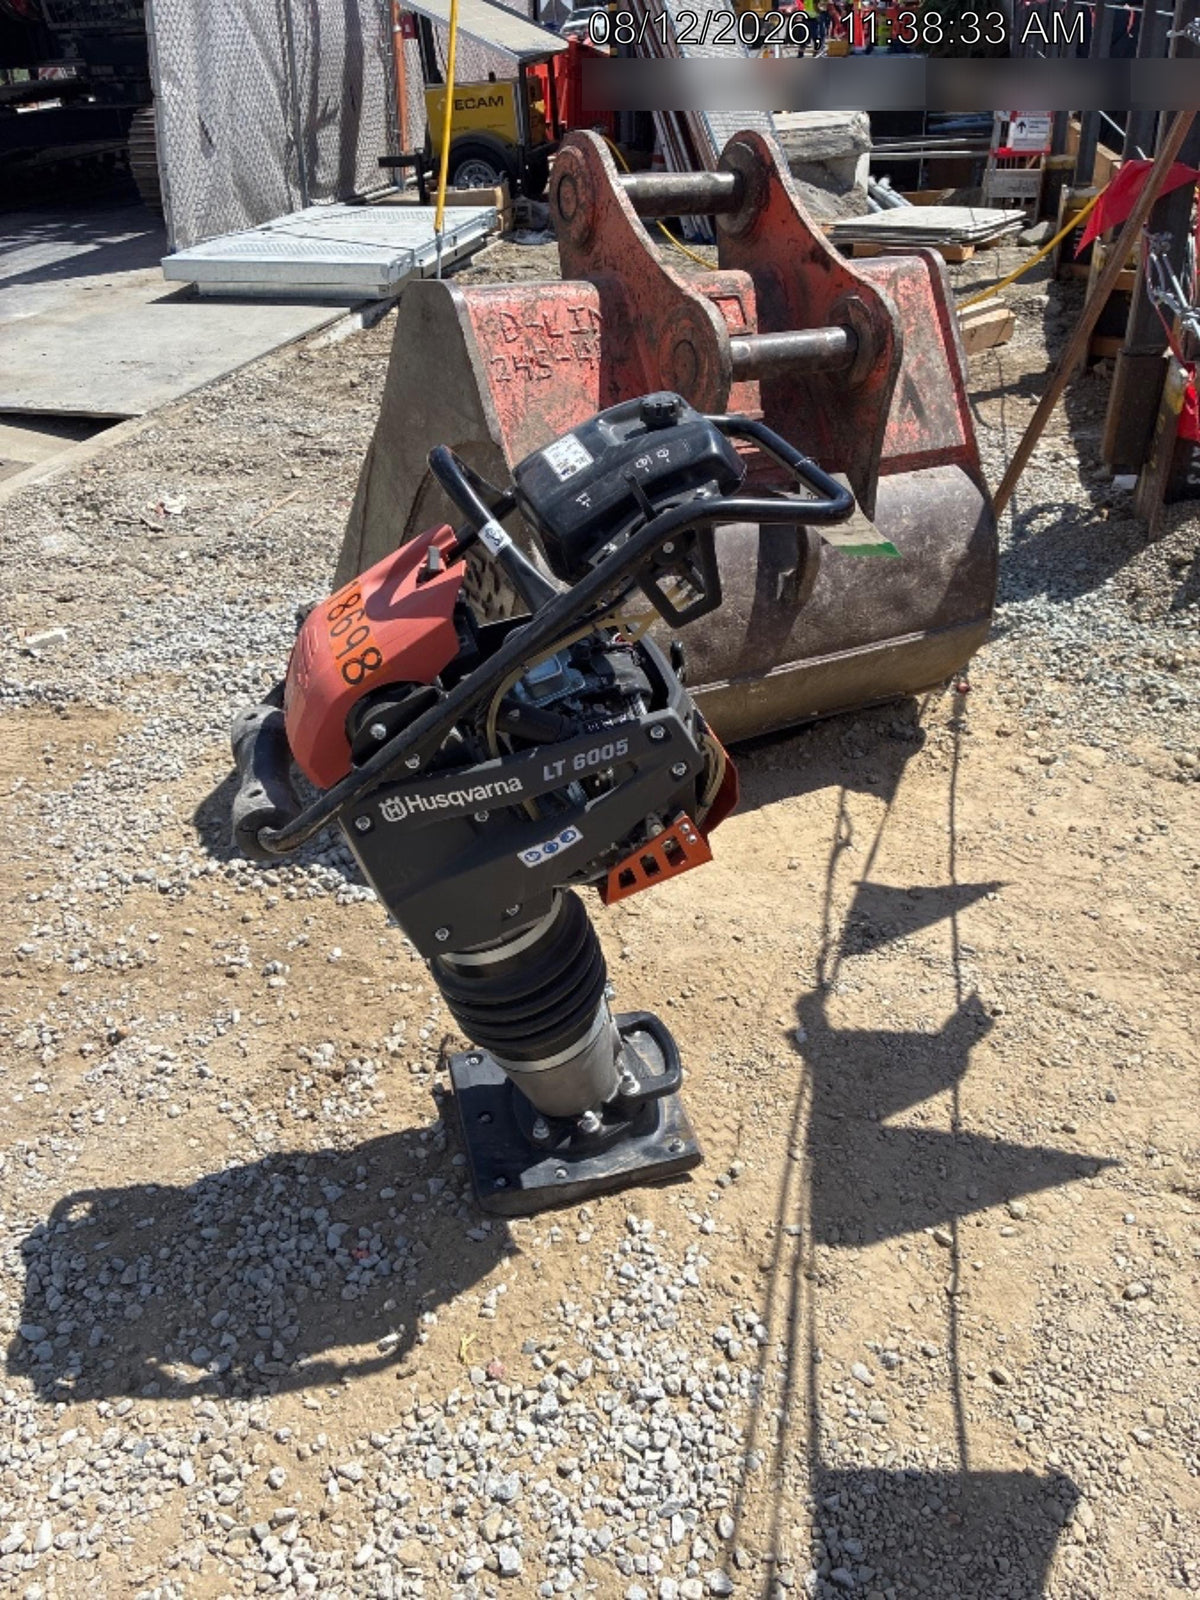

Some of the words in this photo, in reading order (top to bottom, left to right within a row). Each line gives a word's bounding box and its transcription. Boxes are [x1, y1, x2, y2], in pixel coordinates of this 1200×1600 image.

[454, 95, 504, 111] ECAM
[543, 759, 567, 782] LT
[573, 739, 629, 771] 6005
[403, 776, 523, 814] Husqvarna
